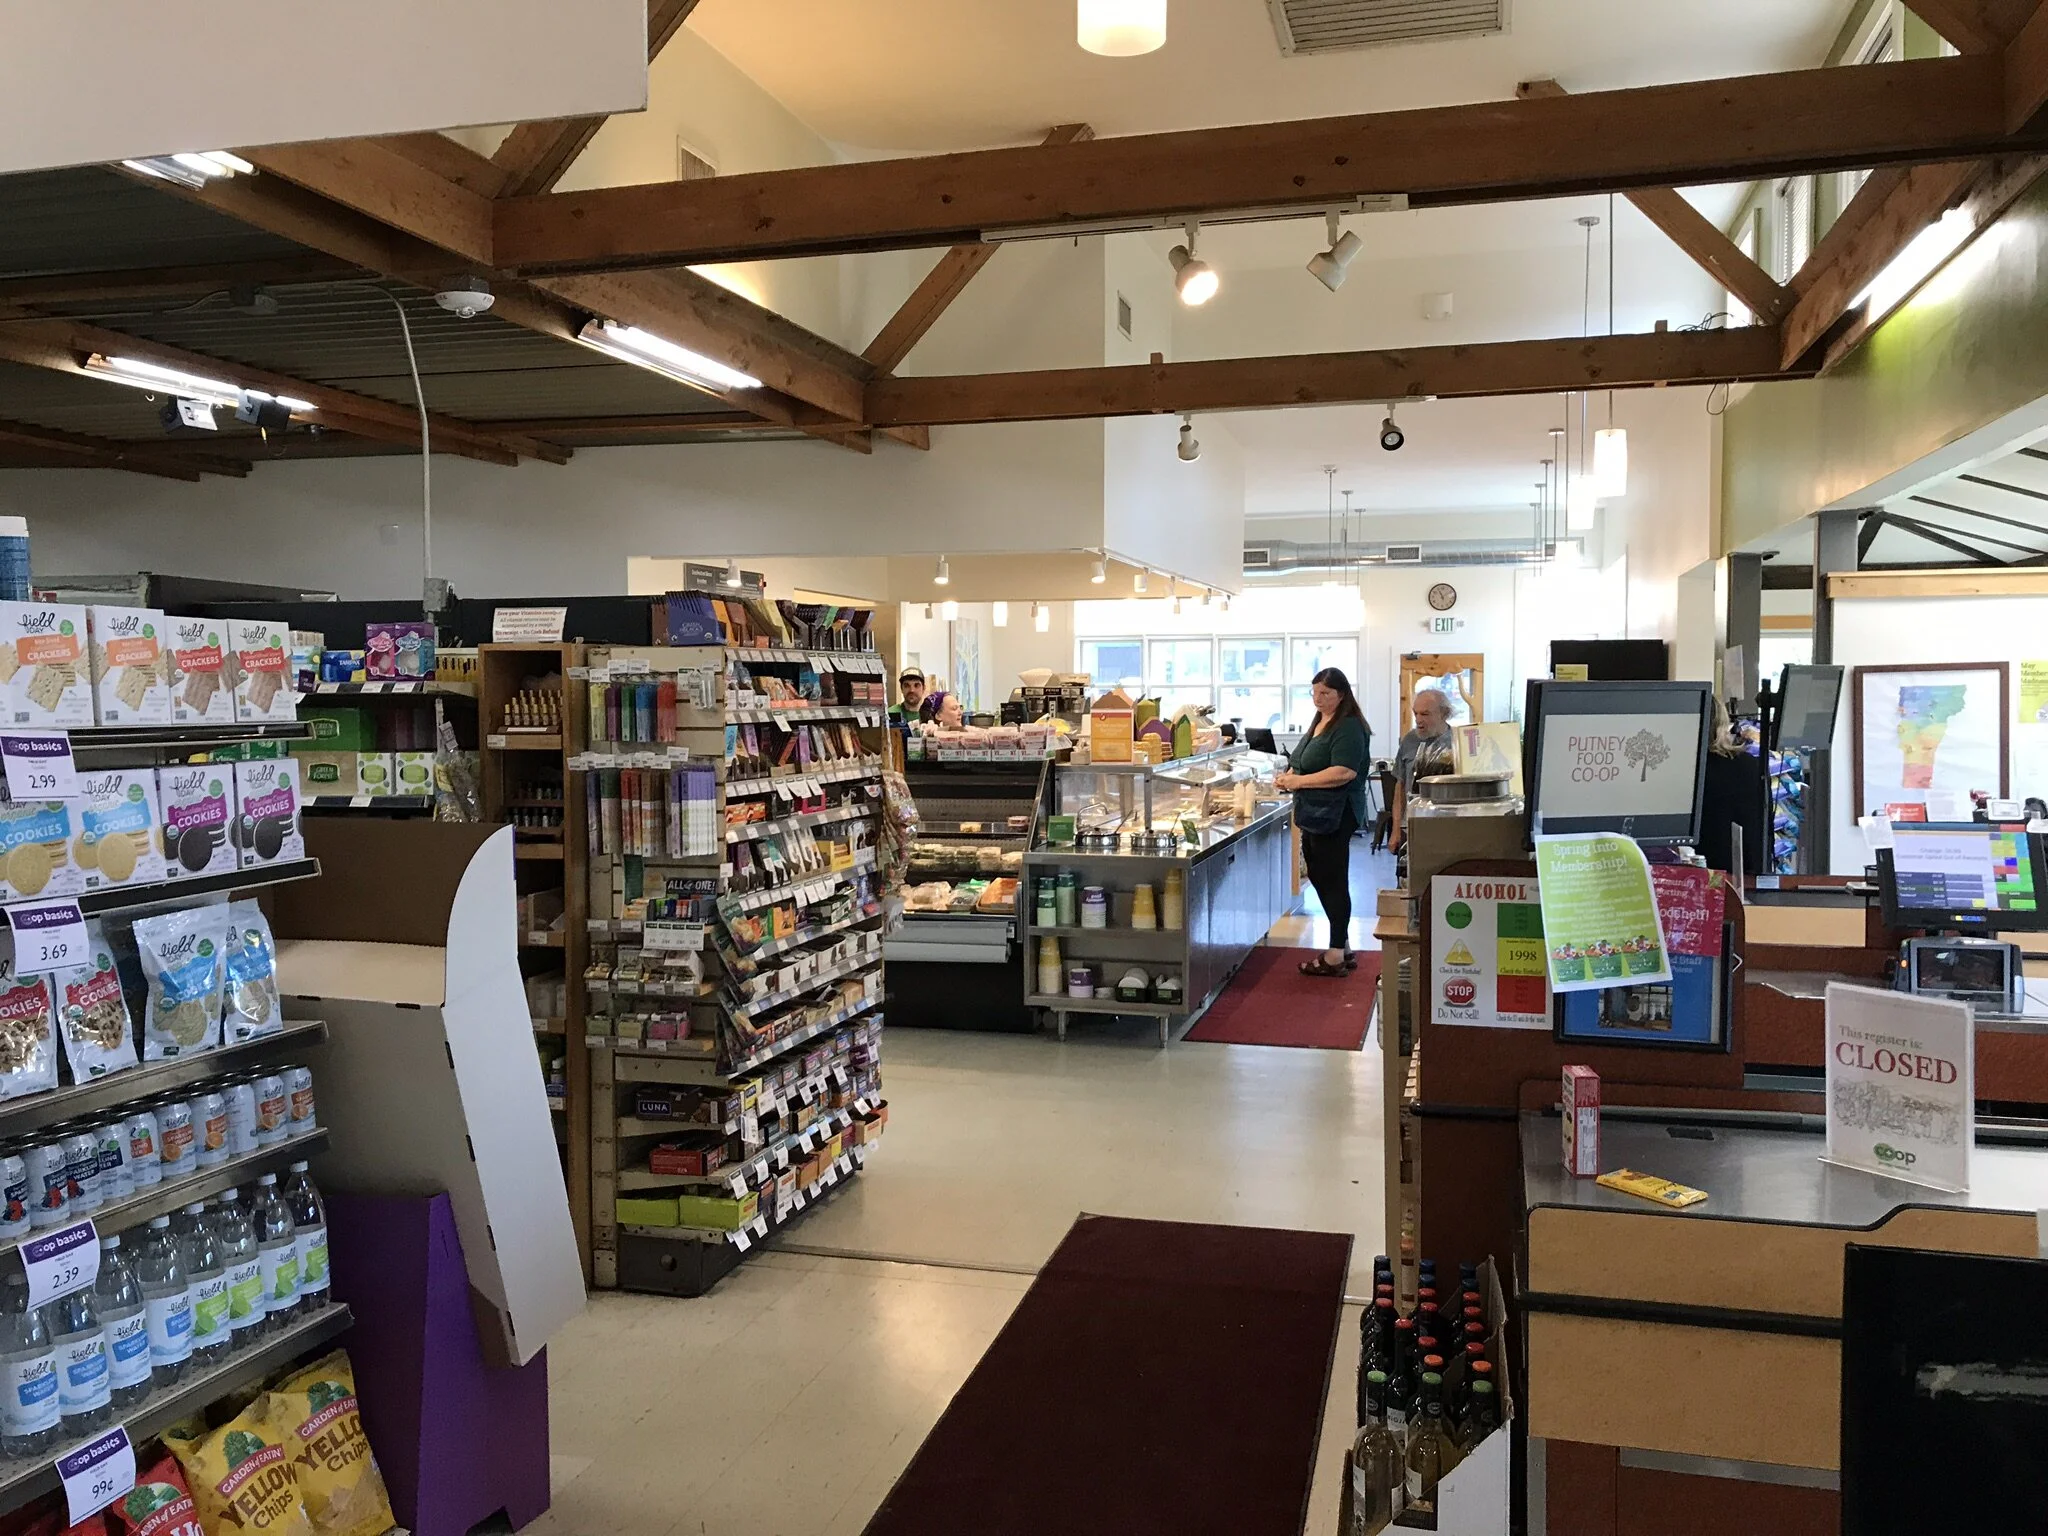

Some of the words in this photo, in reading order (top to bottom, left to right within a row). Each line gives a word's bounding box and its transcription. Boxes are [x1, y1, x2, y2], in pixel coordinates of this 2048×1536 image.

[1435, 617, 1455, 632] EXIT
[27, 648, 71, 660] CRACKERS
[115, 650, 152, 662] CRACKERS
[181, 656, 220, 668] CRACKERS
[245, 656, 282, 668] CRACKERS
[1568, 736, 1626, 752] PUTNEY
[1577, 752, 1614, 765] FOOD
[28, 774, 56, 789] 2.99
[1572, 767, 1620, 782] CO-OP
[252, 800, 290, 818] COOKIES
[94, 814, 144, 834] COOKIES
[177, 808, 222, 828] COOKIES
[5, 823, 62, 844] COOKIES
[1553, 843, 1591, 857] Spring
[1550, 855, 1628, 873] Membership!
[668, 880, 684, 890] ALL
[695, 880, 716, 891] ONE!
[1454, 882, 1528, 900] ALCOHOL
[1653, 877, 1696, 889] ommunity
[1656, 888, 1688, 899] porting
[41, 944, 67, 961] 3.69
[1510, 950, 1537, 961] 1998
[80, 980, 119, 1006] COOKIES
[1447, 986, 1473, 996] STOP
[0, 997, 42, 1018] OKIES
[1438, 1007, 1449, 1019] Do
[1450, 1008, 1464, 1019] Not
[1839, 1025, 1863, 1040] This
[1864, 1031, 1909, 1049] register
[1910, 1038, 1923, 1050] is:
[1835, 1041, 1958, 1085] CLOSED
[642, 1103, 668, 1112] LUNA
[52, 1266, 79, 1289] 2.39
[301, 1405, 337, 1437] GARDEN
[295, 1414, 364, 1471] YELLO
[327, 1437, 368, 1471] Chips
[222, 1459, 255, 1493] GARDEN
[219, 1462, 299, 1529] YELLOW
[254, 1489, 295, 1528] Chips
